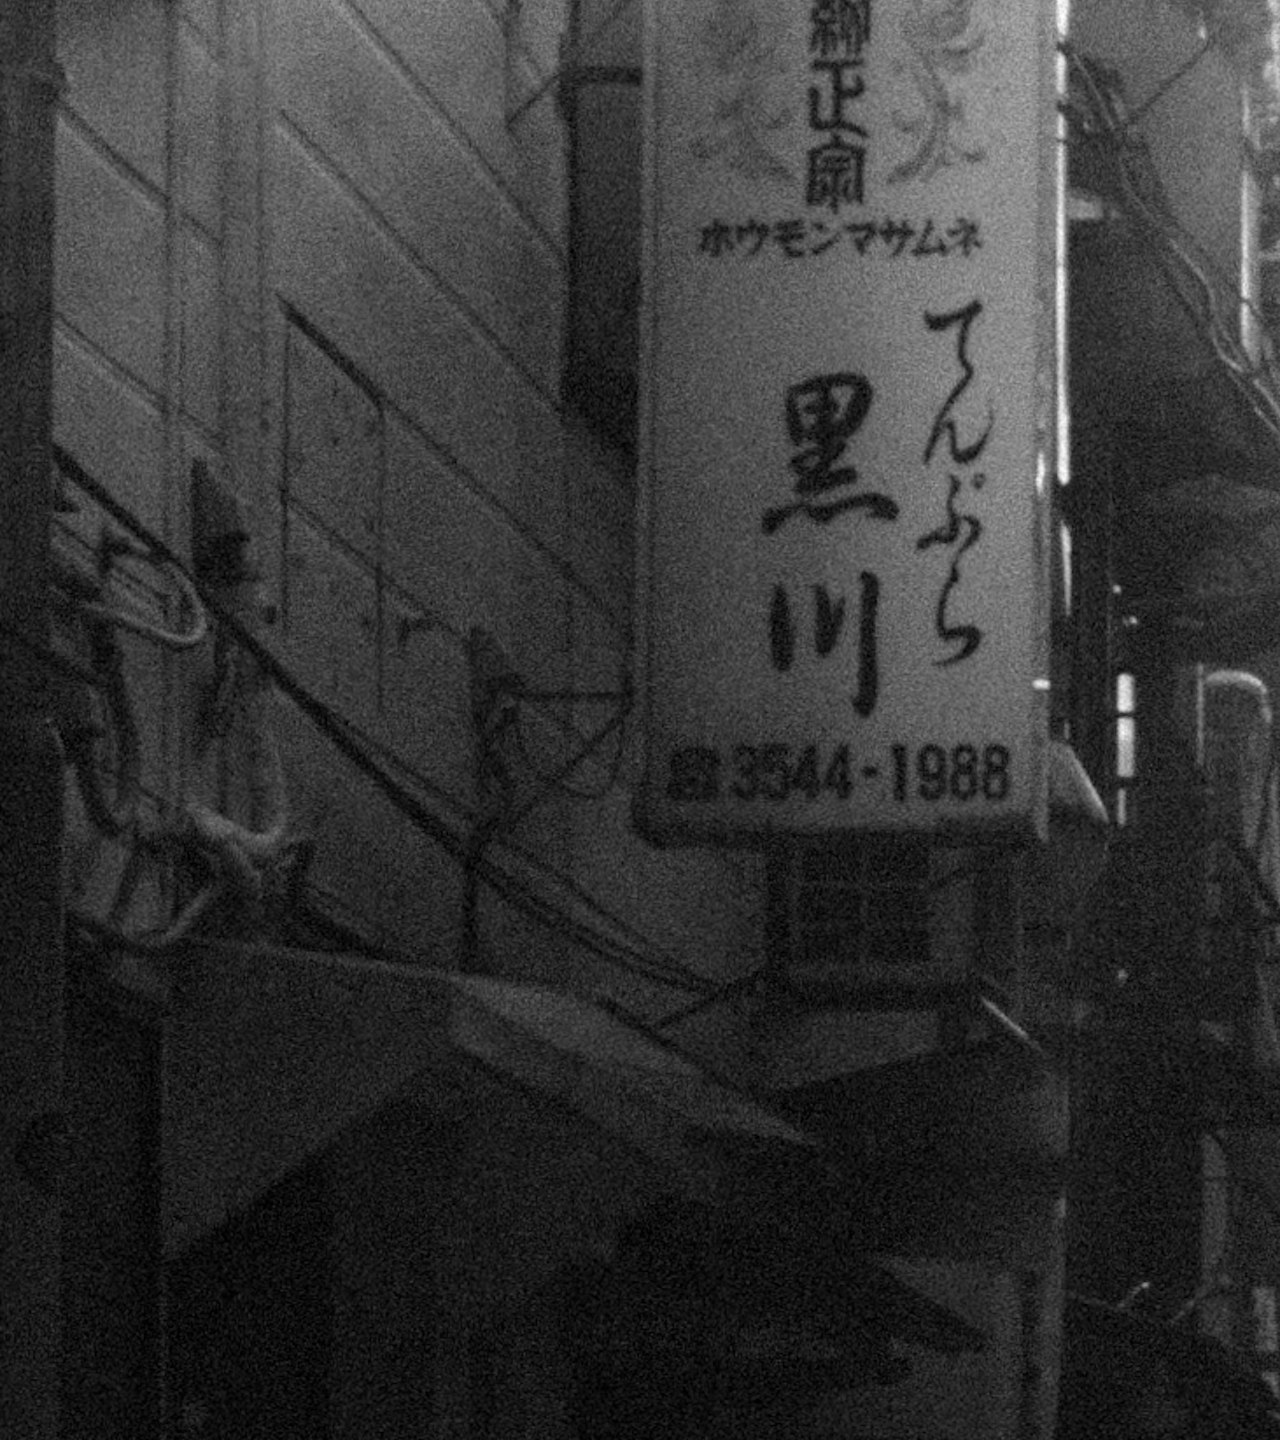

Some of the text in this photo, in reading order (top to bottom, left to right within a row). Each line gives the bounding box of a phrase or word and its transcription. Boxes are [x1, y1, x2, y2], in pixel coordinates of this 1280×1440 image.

[698, 217, 984, 260] ホウモンマサムネ
[760, 370, 900, 720] 黒川
[915, 298, 996, 668] てんぷら
[730, 743, 1013, 804] 3544-1988
